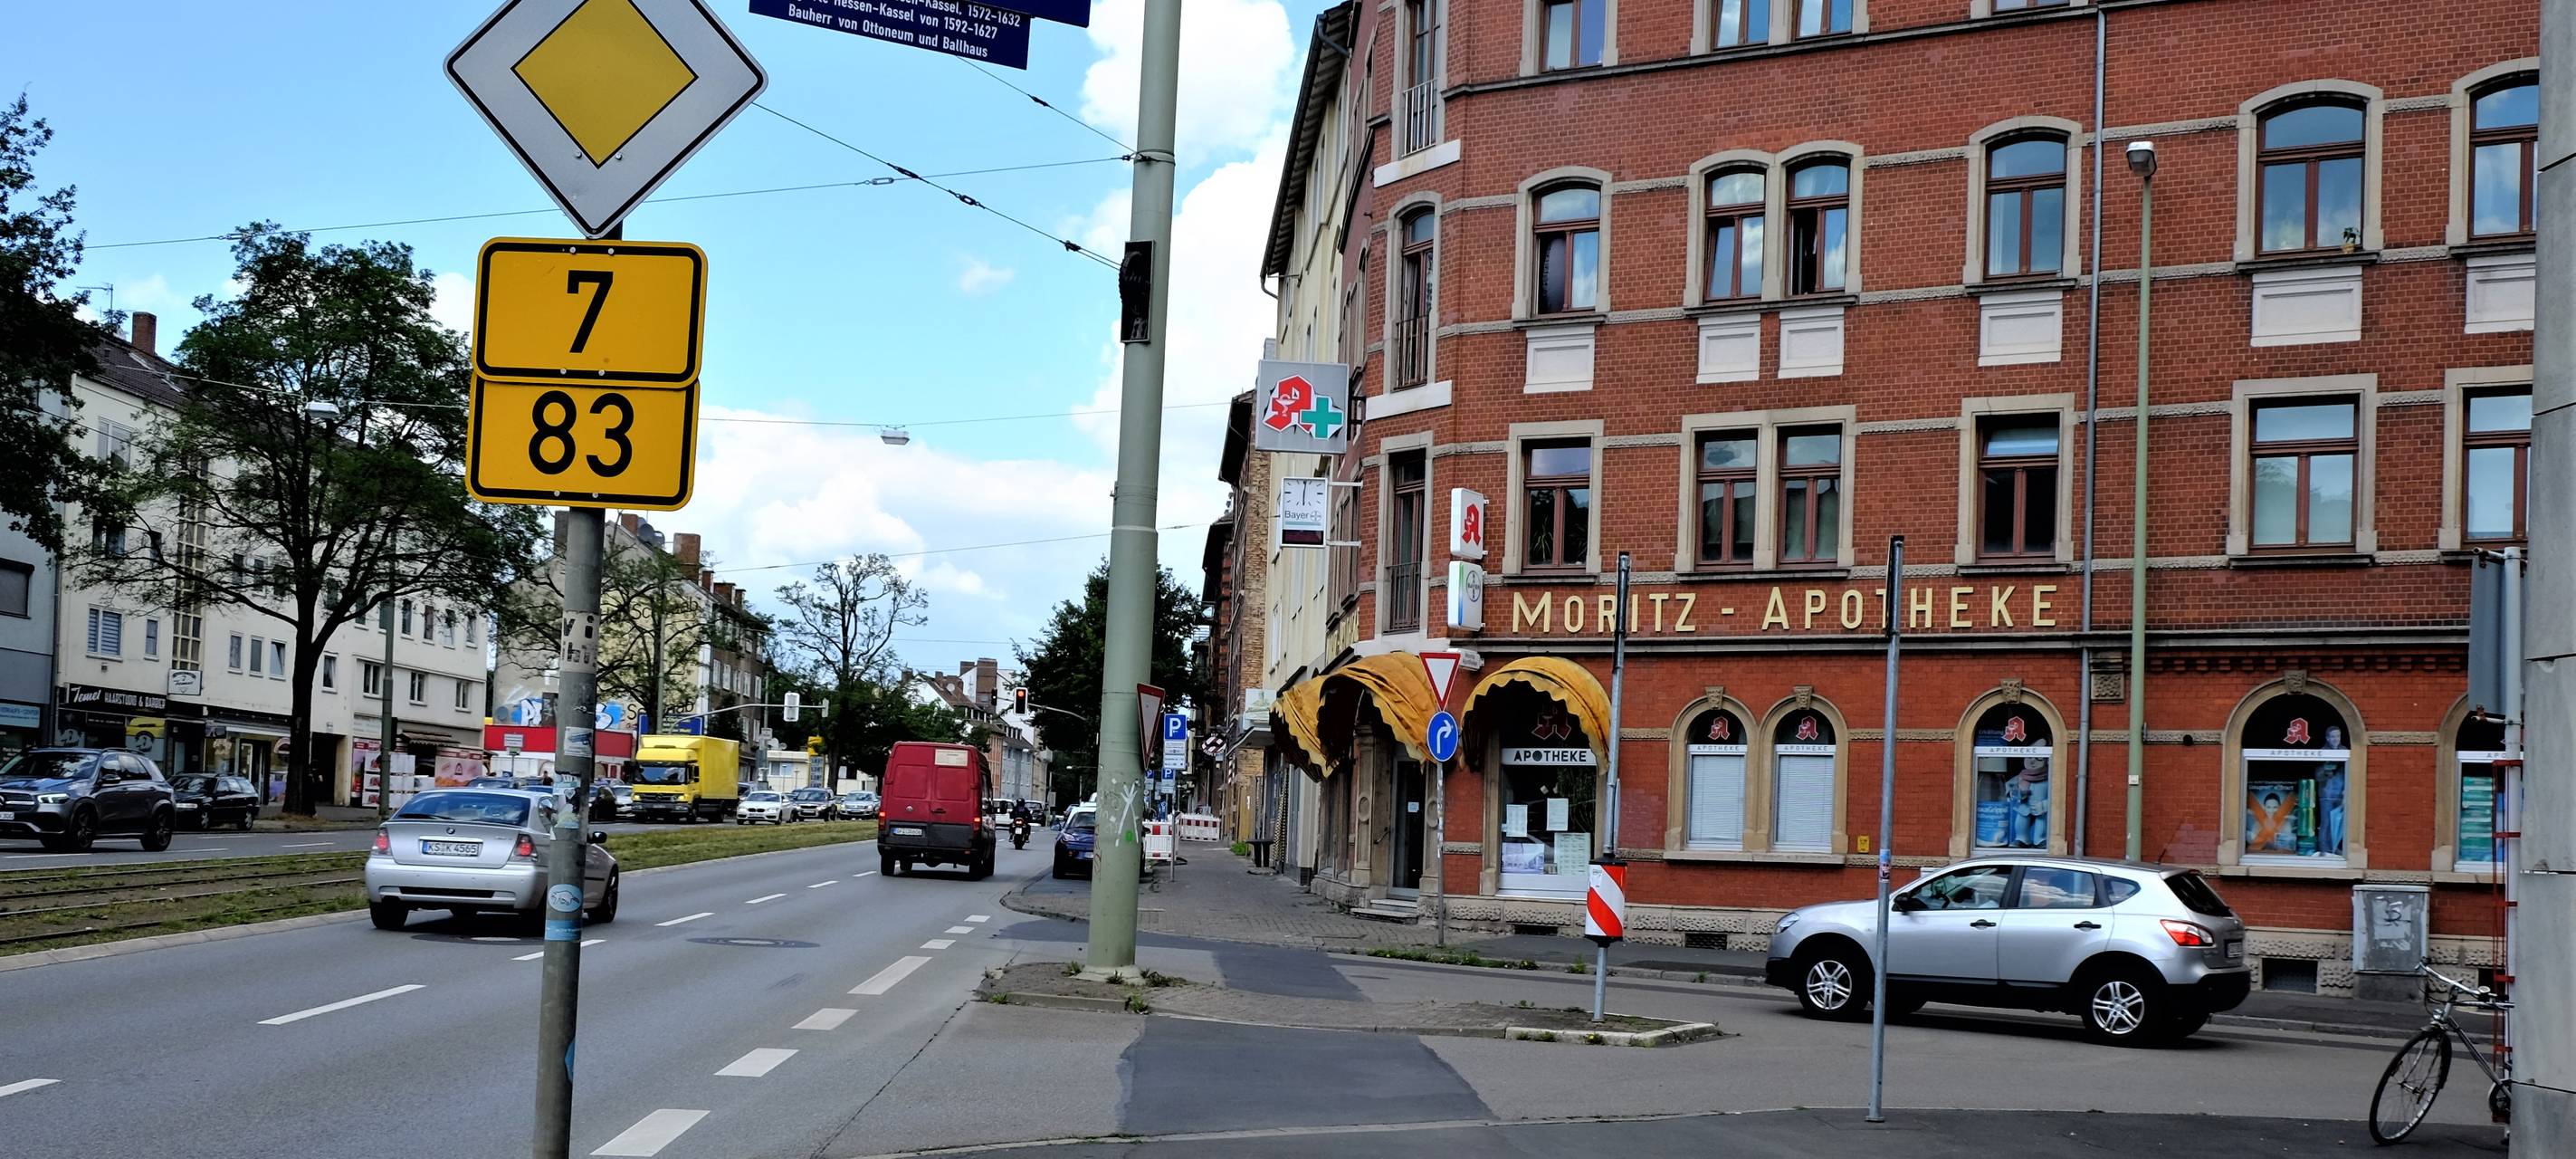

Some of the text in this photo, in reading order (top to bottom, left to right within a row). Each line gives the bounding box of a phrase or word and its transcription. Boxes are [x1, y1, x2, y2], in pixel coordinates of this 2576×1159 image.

[920, 14, 939, 27] von
[944, 17, 997, 39] 1592-1627
[968, 4, 1021, 27] 1572-1632
[788, 4, 988, 57] Bauherr von Ottoneum und Ballhaus
[567, 270, 614, 354] 7
[529, 390, 634, 477] 83
[1284, 510, 1309, 521] Bayer
[1512, 590, 1696, 633] MORITZ
[1761, 584, 2057, 631] APOTHEKE
[71, 685, 101, 703] Temel
[1169, 717, 1181, 737] P
[1513, 750, 1587, 762] APOTHEKE
[428, 842, 440, 852] KS
[453, 844, 476, 853] 4565
